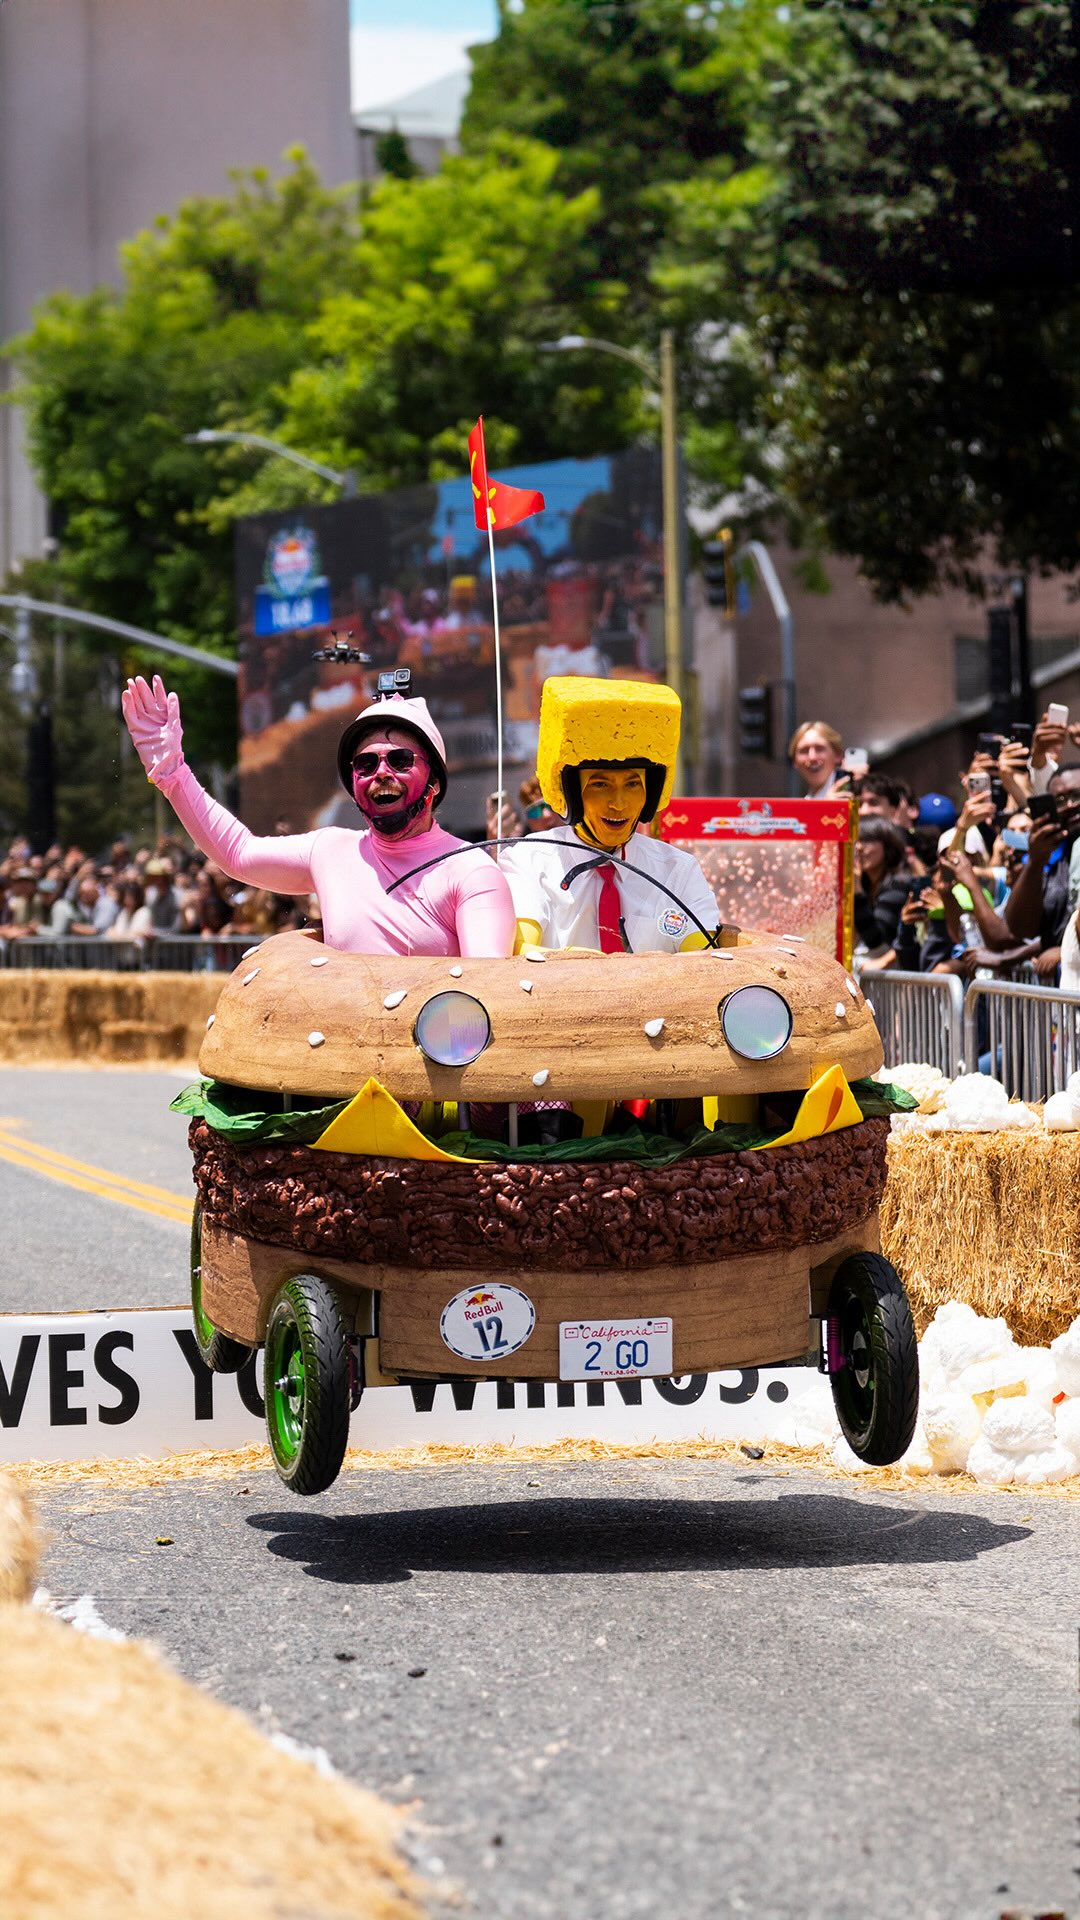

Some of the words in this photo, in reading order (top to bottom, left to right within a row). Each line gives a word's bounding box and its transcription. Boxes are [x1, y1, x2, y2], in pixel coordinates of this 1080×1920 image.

[464, 1306, 484, 1321] Red
[484, 1301, 504, 1315] Bull
[472, 1316, 509, 1352] 12
[581, 1325, 653, 1342] California
[585, 1341, 602, 1371] 2
[616, 1339, 649, 1370] GO
[0, 1329, 141, 1428] VES
